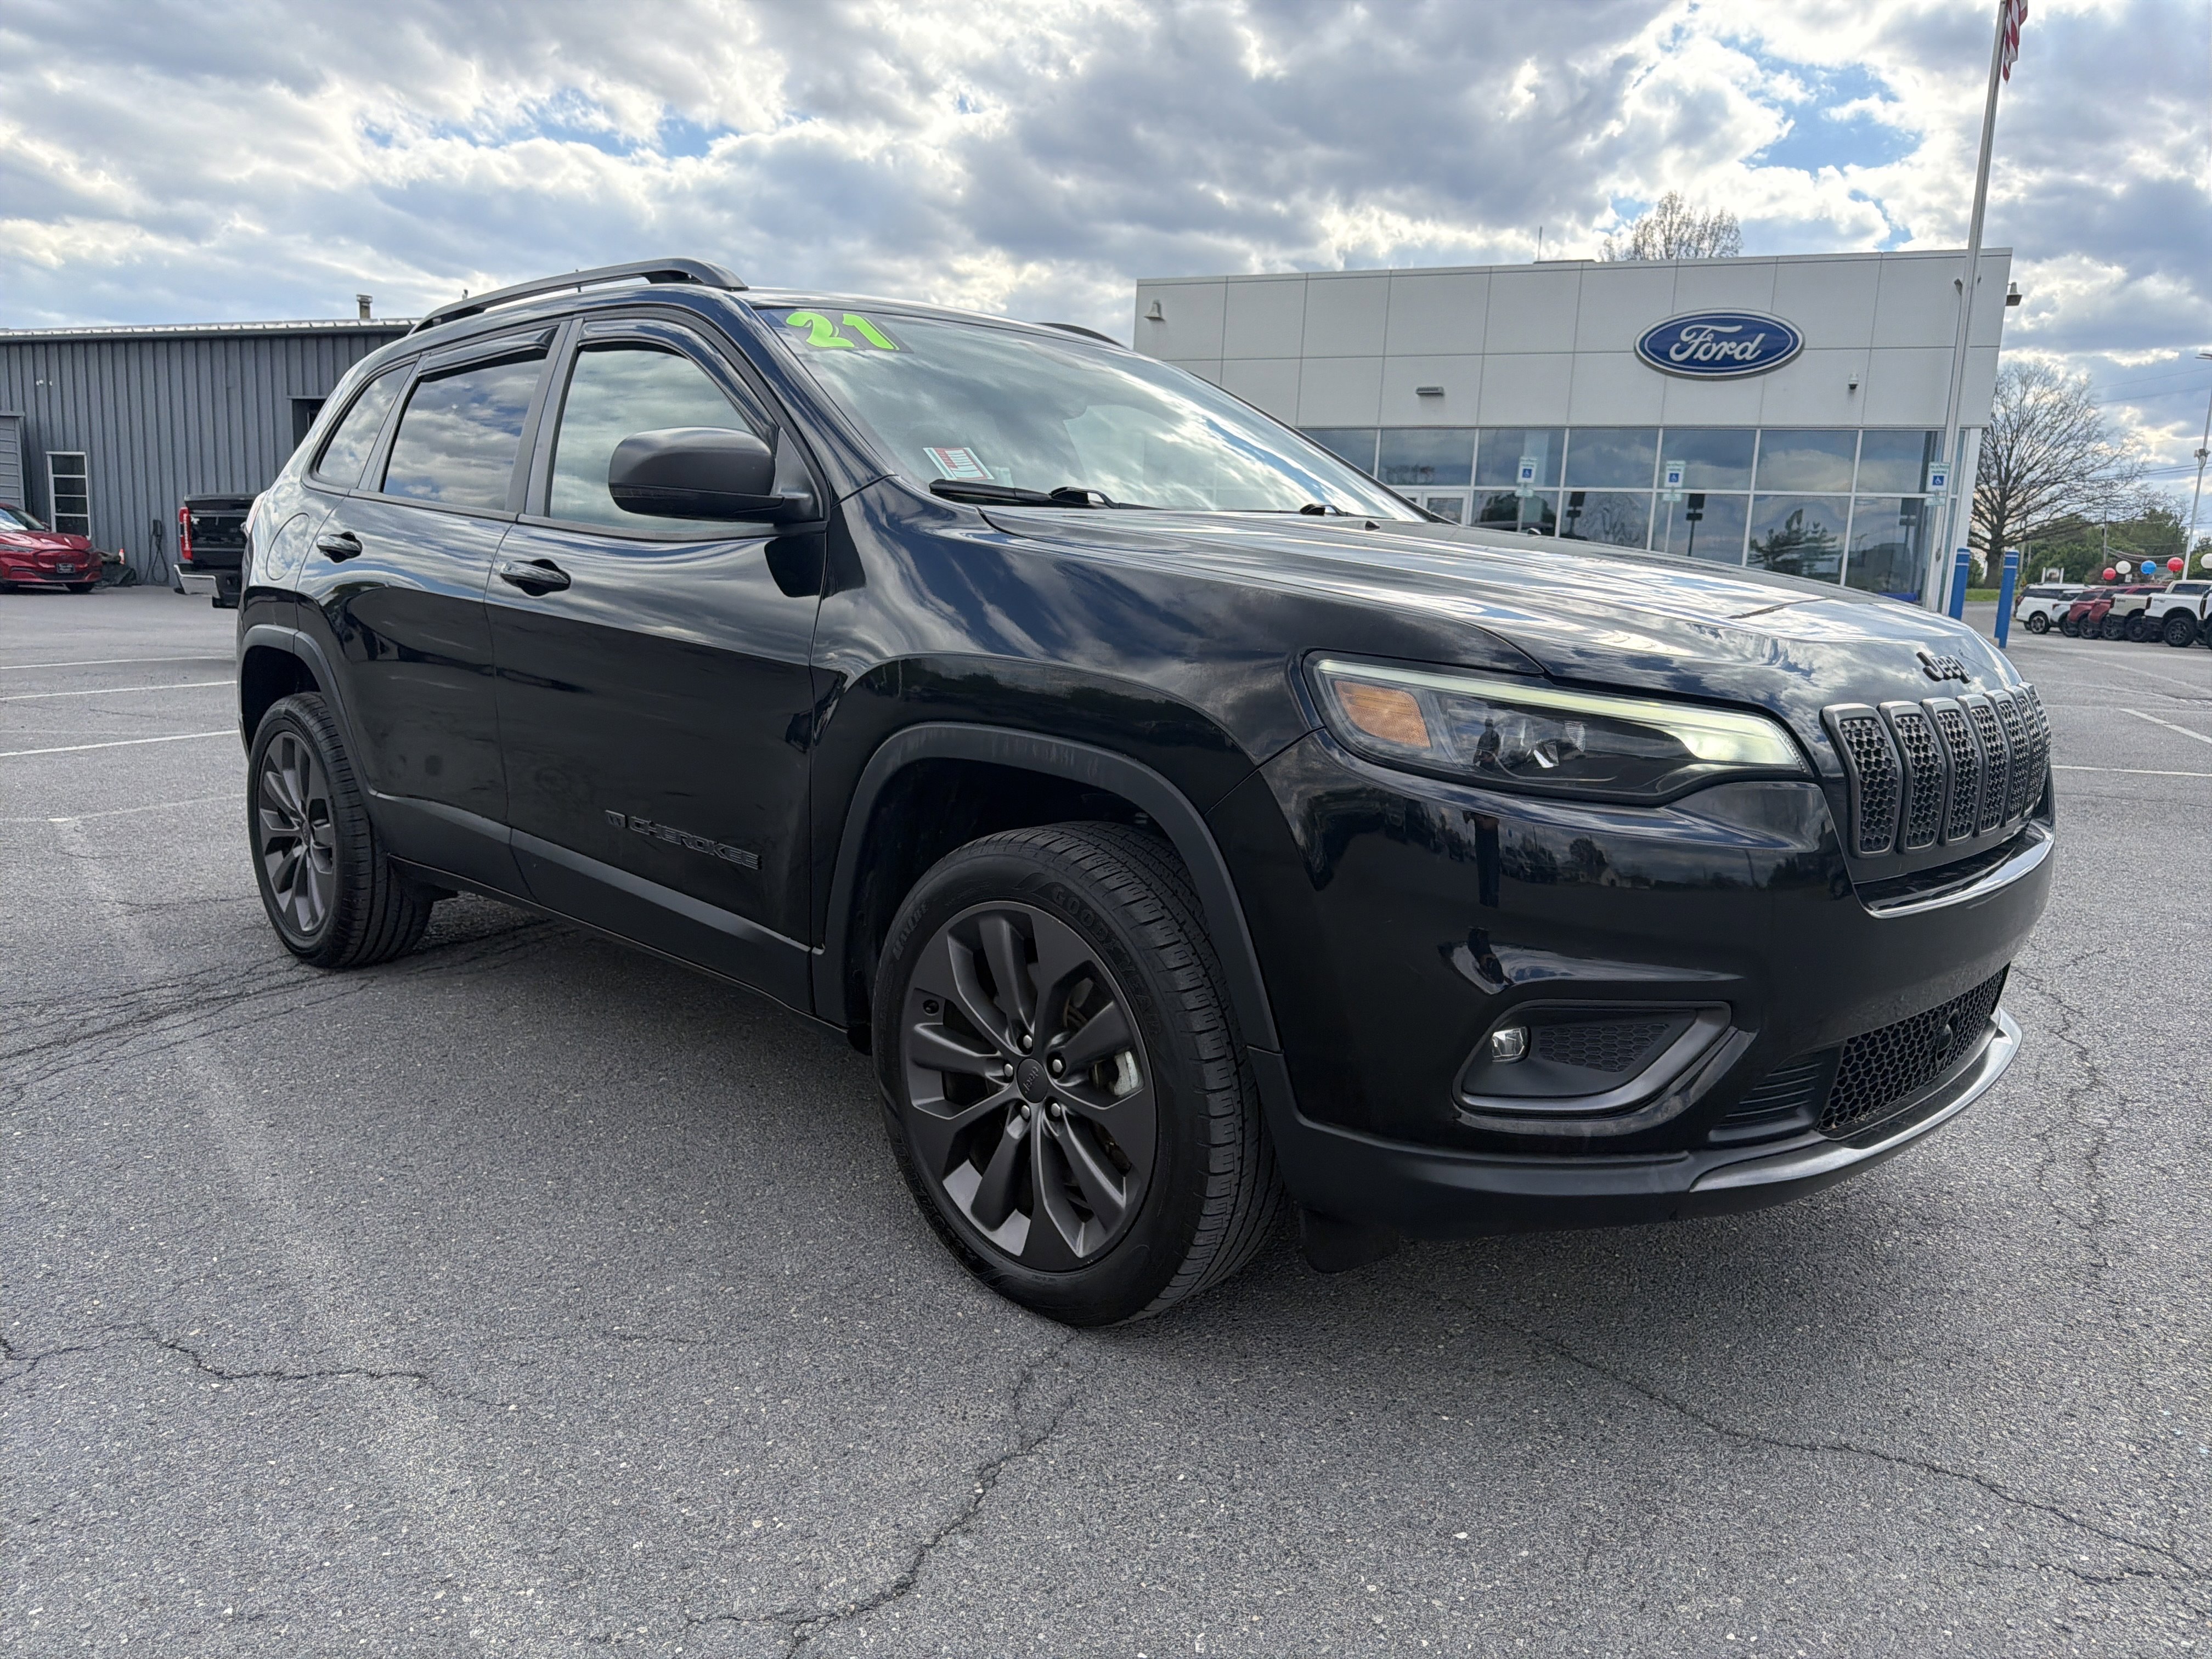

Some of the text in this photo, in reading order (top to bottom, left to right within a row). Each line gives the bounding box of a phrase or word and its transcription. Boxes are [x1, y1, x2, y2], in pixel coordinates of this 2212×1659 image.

[786, 312, 899, 350] 21
[1669, 324, 1765, 361] Ford
[1916, 652, 1971, 684] Jeep
[628, 816, 761, 871] CHEROKEE
[1023, 1065, 1040, 1094] Jeep
